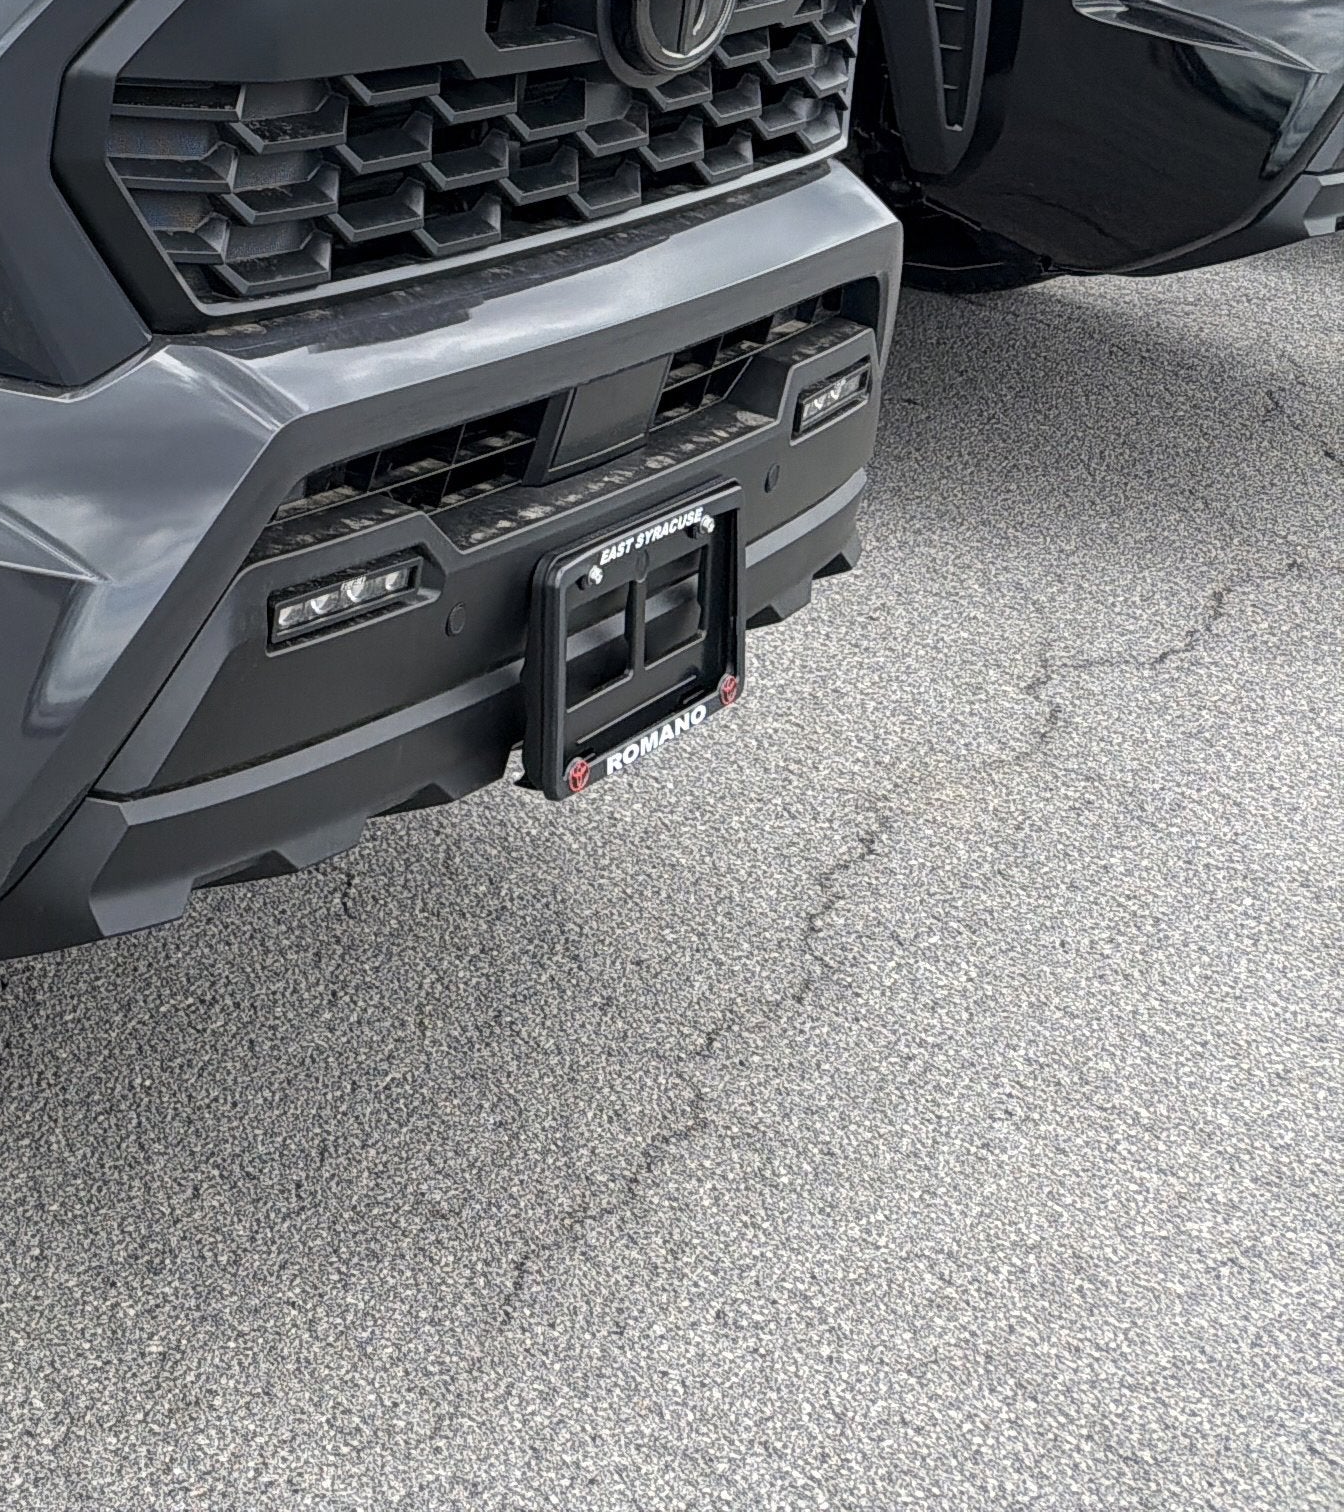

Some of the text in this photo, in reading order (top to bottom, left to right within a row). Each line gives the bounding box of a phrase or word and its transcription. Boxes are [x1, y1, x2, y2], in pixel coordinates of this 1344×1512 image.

[599, 506, 704, 566] EAST SYRACUSE
[606, 704, 707, 775] ROMANO
